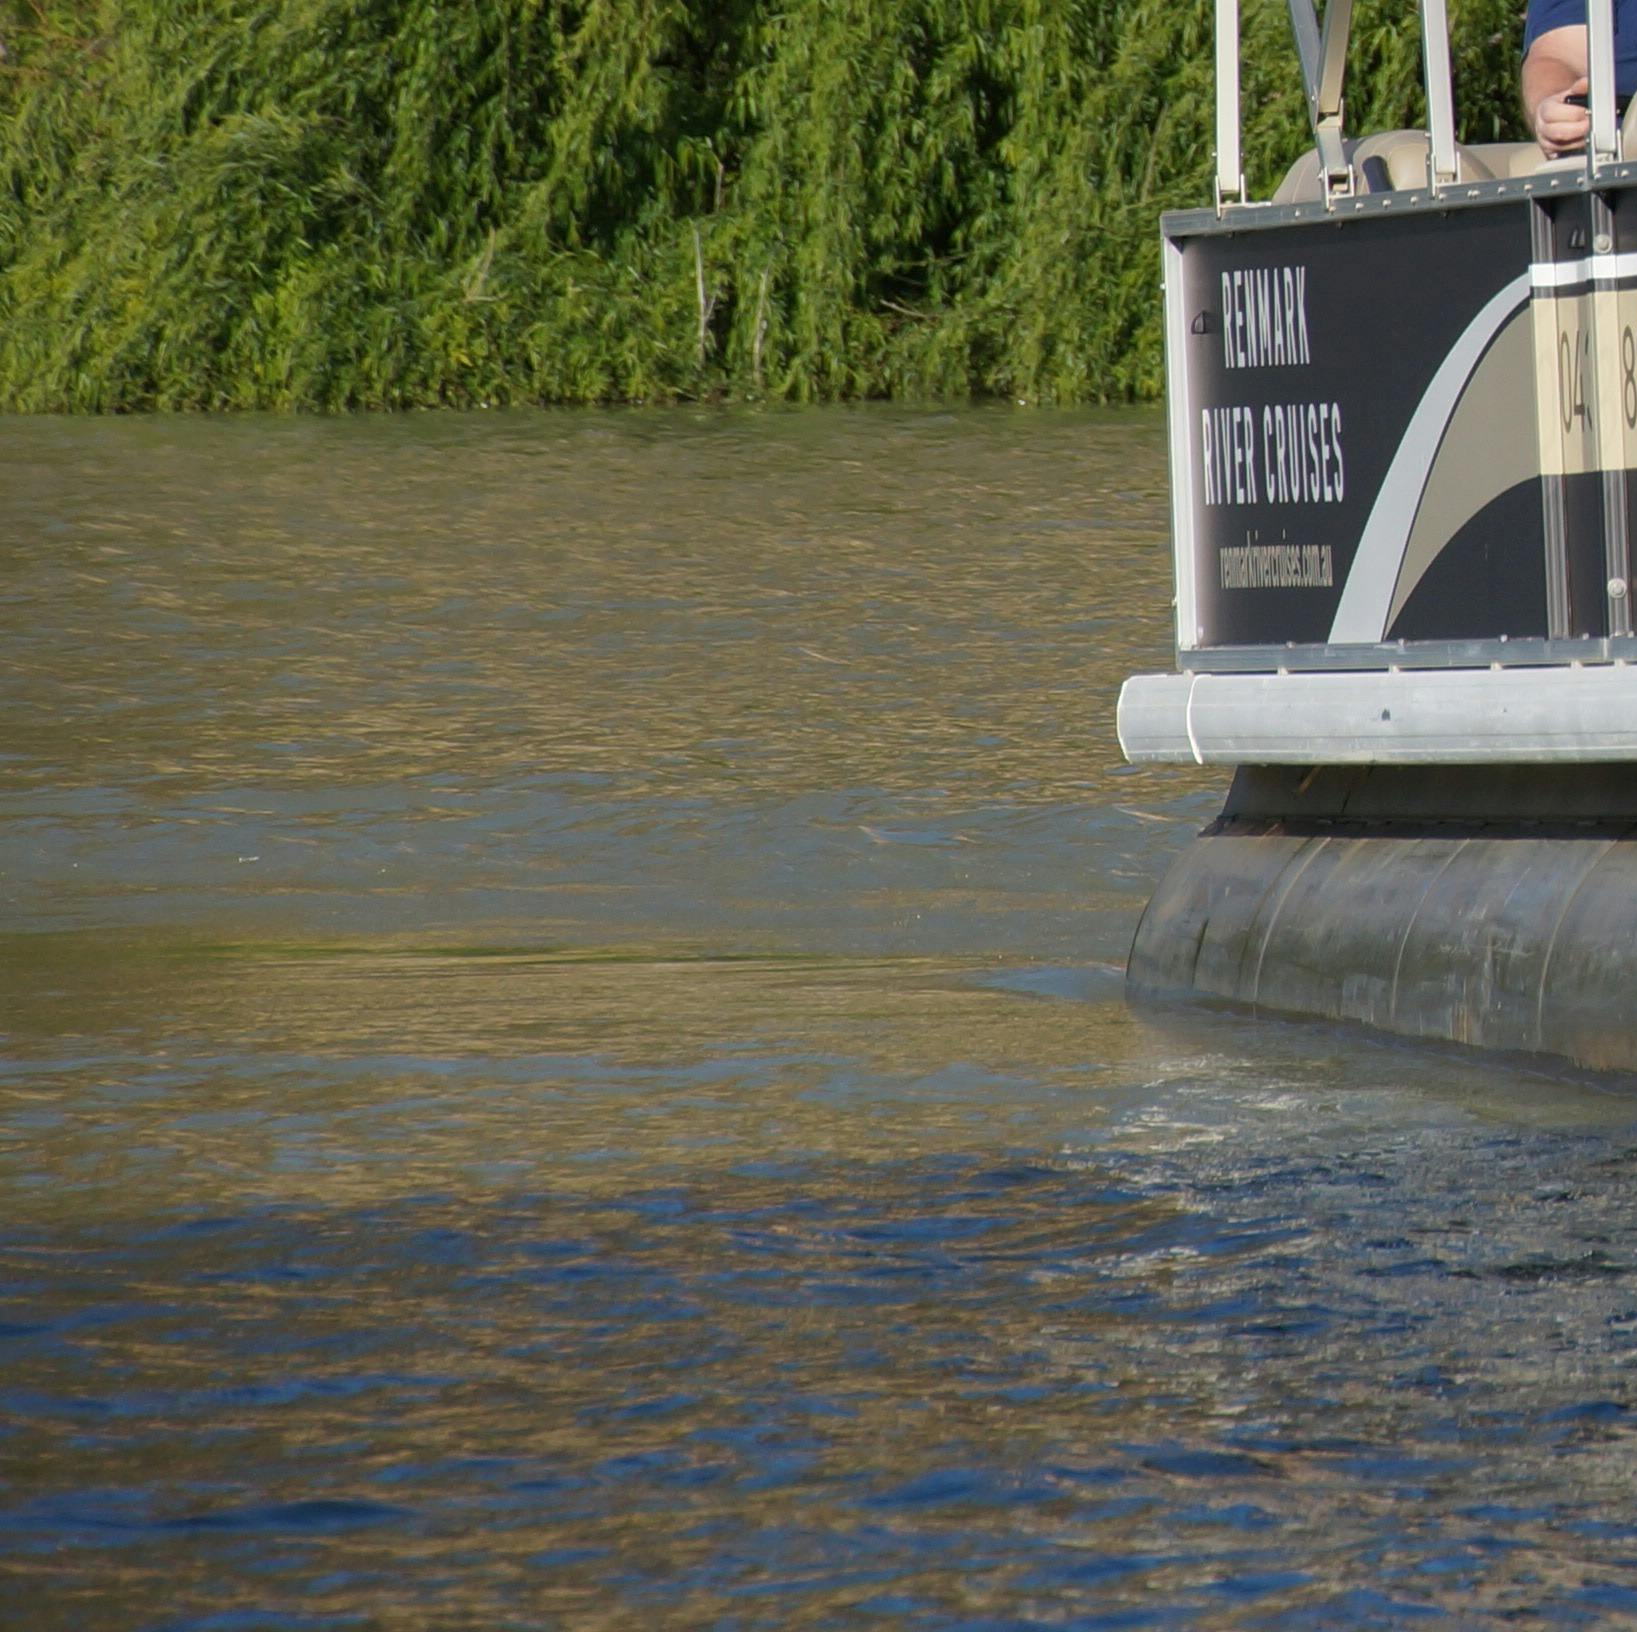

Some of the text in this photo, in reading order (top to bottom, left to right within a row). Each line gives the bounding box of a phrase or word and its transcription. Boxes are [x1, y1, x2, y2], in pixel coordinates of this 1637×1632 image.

[1221, 266, 1311, 368] RENMARK
[1202, 402, 1345, 505] RIVER CRUISES
